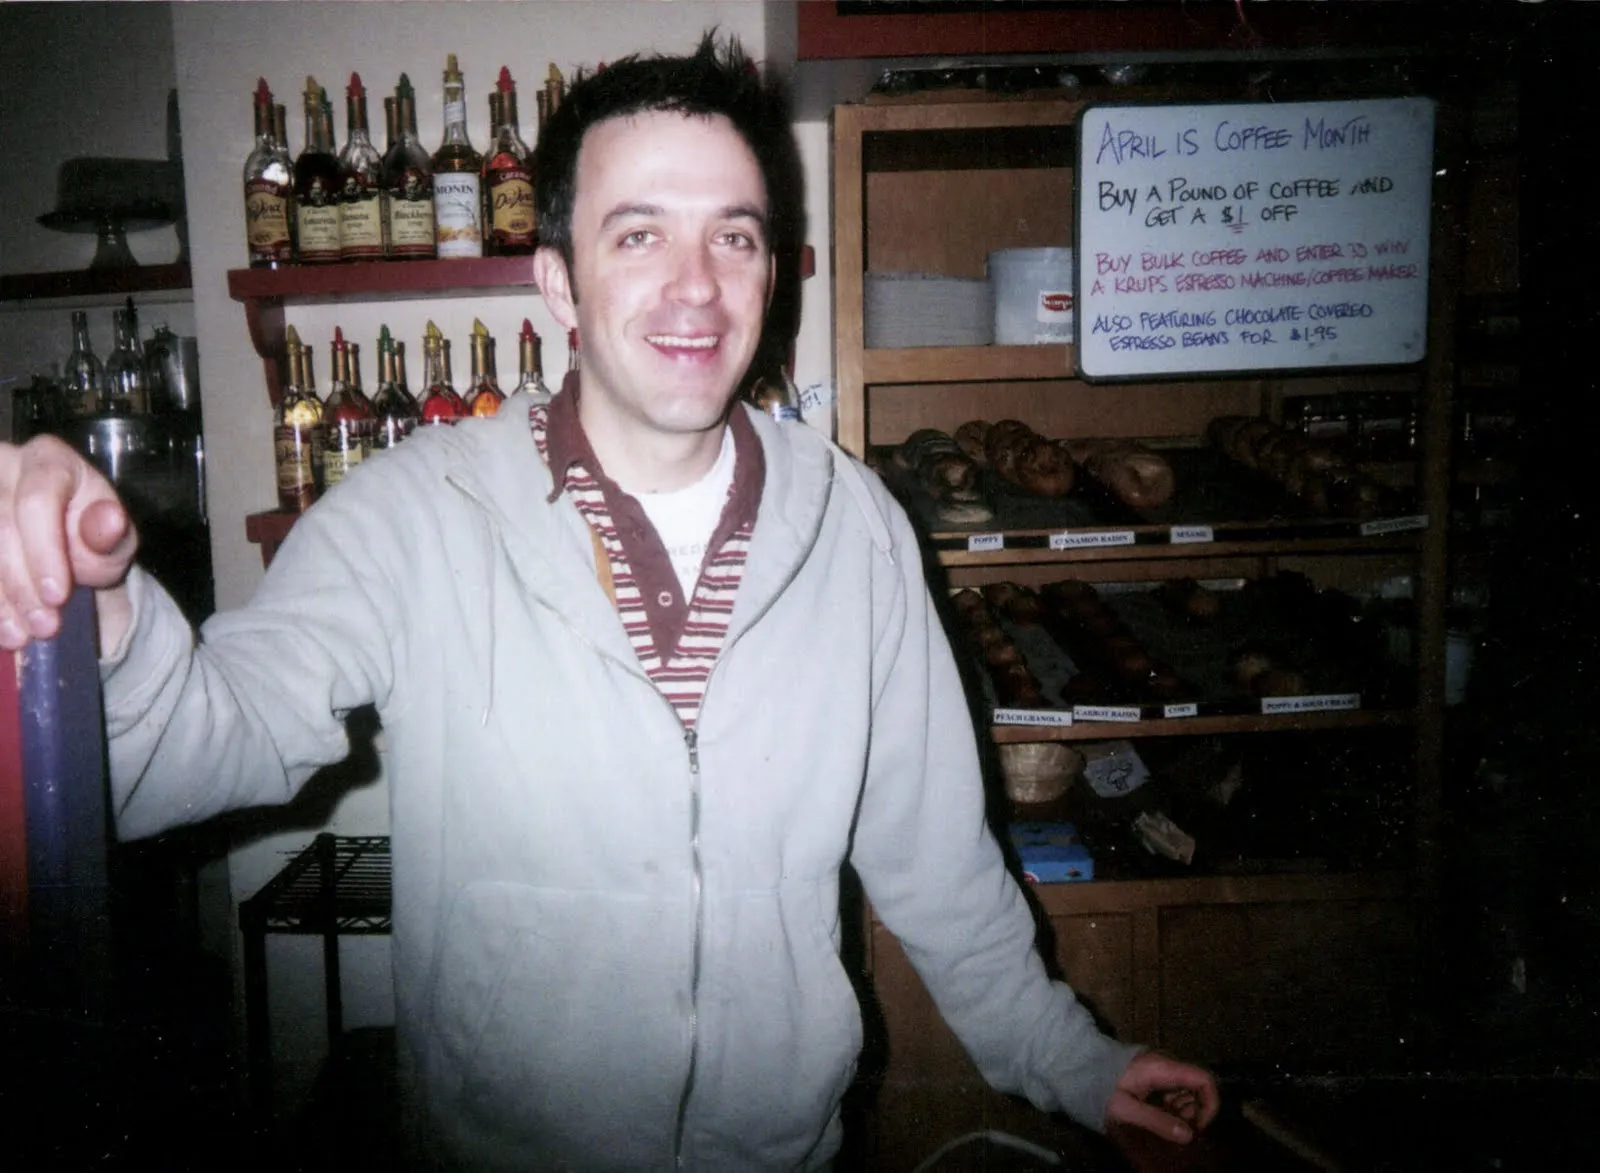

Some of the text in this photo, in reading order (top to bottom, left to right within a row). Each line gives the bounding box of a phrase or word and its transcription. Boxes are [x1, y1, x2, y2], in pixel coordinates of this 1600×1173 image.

[1096, 115, 1369, 165] APRIL IS COFFEE MONTH
[434, 184, 474, 195] MONIN
[1098, 176, 1393, 216] BUY A POUND OF COFFEE AND
[1144, 204, 1299, 228] GET A $1 OFF
[1095, 252, 1132, 275] BUY
[1140, 252, 1186, 272] BULK
[1191, 248, 1248, 267] COFFEE
[1255, 247, 1290, 262] AND
[1295, 242, 1345, 261] ENTER
[1374, 239, 1410, 255] WIN
[1091, 279, 1105, 296] A
[1115, 275, 1168, 294] KRUPS
[1175, 273, 1236, 293] ESPRESSO
[1368, 263, 1422, 280] MAKER
[1091, 303, 1374, 335] ALSO FEATURING CHOCOLATE COVERED
[1109, 326, 1338, 352] ESPRESSO BEANS FOR $1.95
[974, 536, 998, 545] POPPY
[1101, 534, 1129, 543] RAISIN
[996, 713, 1062, 723] PEACH GRANOLA
[1075, 709, 1138, 719] CARROT RAISIN
[1267, 702, 1292, 711] POPPY
